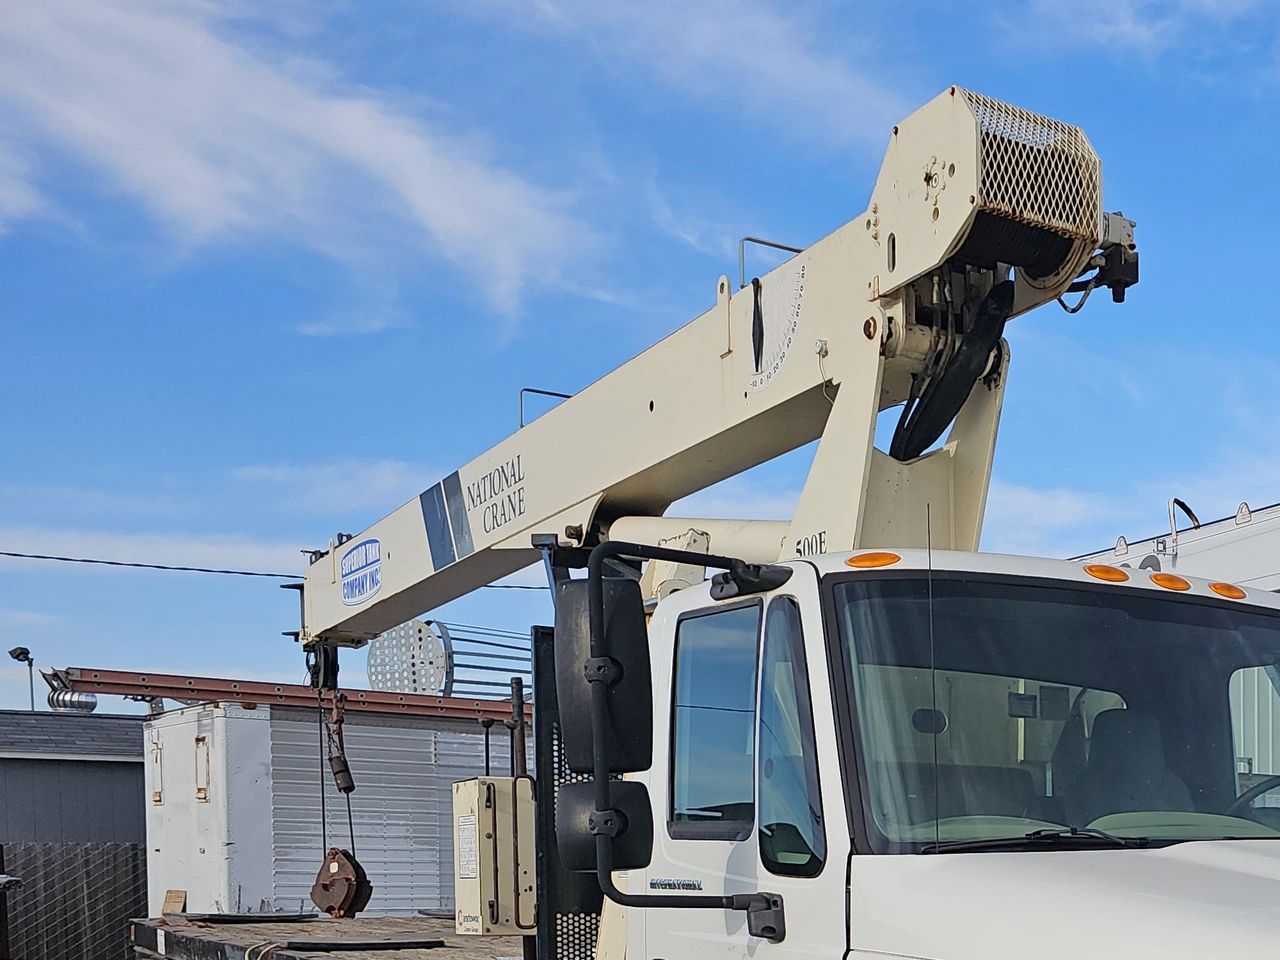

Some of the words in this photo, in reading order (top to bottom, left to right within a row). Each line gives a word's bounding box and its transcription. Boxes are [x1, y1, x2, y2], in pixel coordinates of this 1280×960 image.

[772, 362, 779, 374] 20
[779, 352, 786, 364] 30
[786, 337, 792, 349] 40
[467, 454, 525, 511] NATIONAL
[483, 487, 526, 533] CRANE
[343, 573, 368, 600] COMPANY
